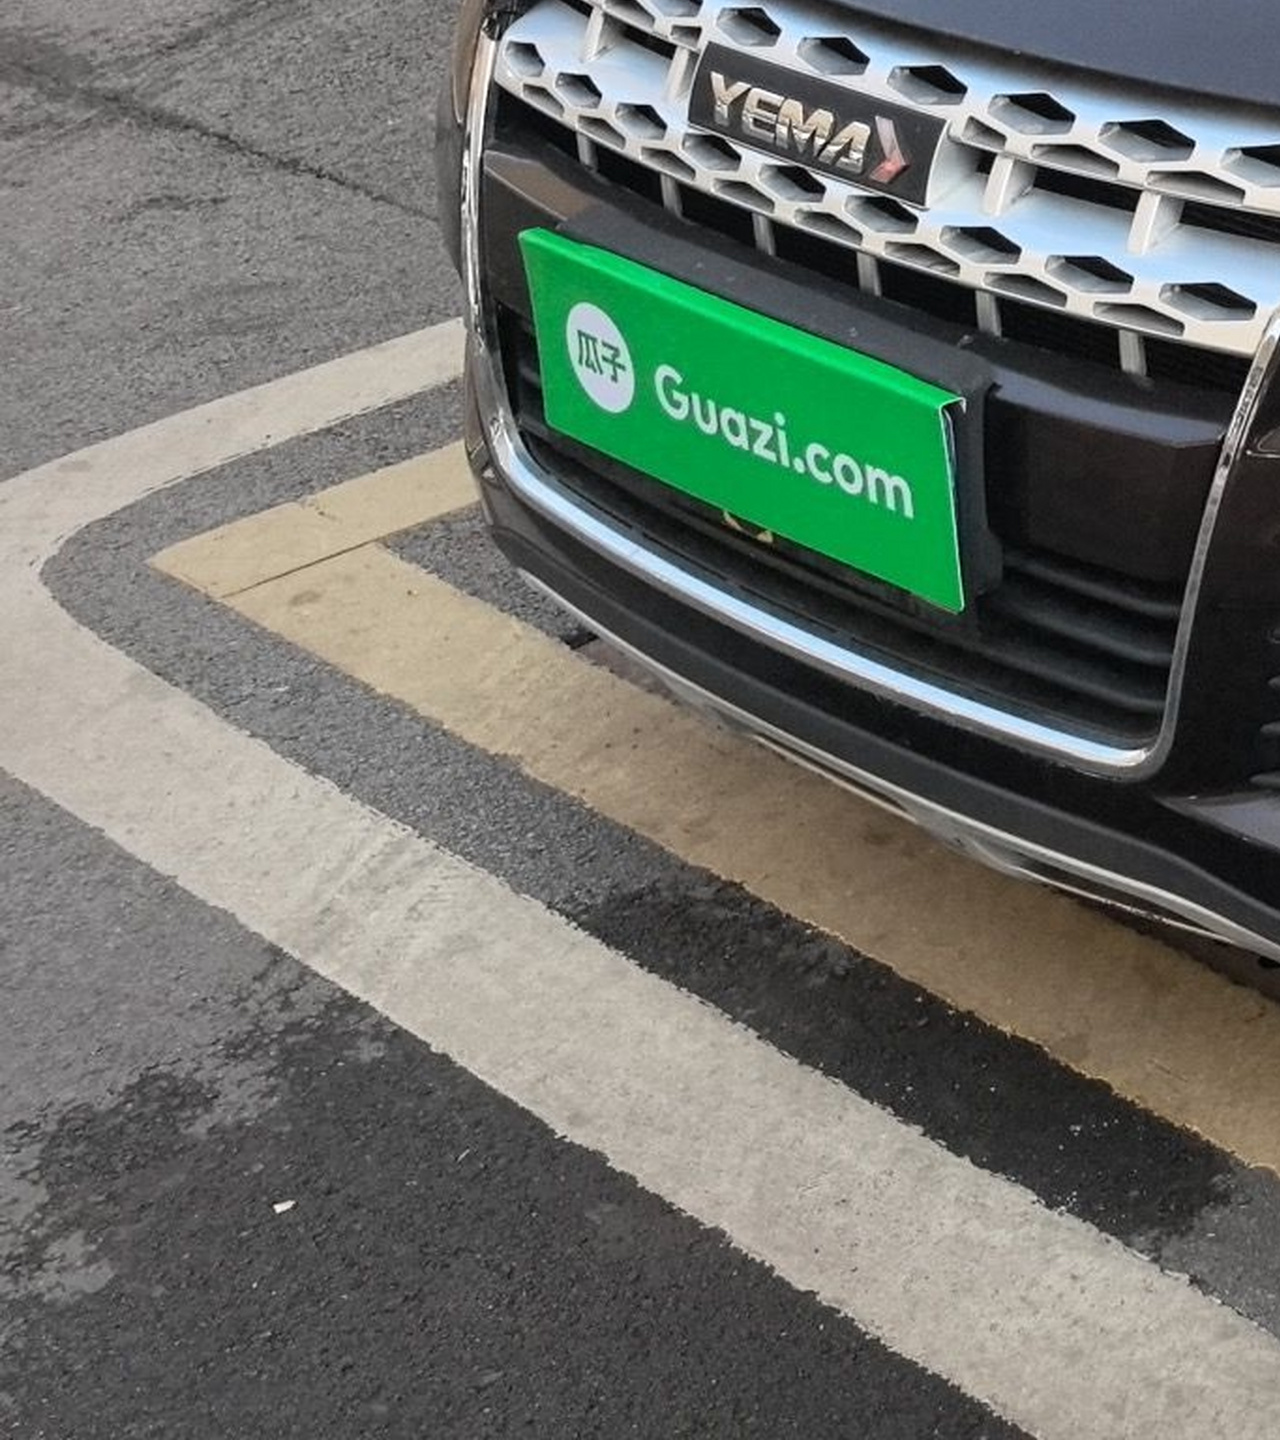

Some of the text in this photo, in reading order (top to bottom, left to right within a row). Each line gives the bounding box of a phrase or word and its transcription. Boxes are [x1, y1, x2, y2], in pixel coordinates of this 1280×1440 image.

[710, 71, 871, 174] YEMA
[576, 328, 627, 385] 瓜子
[653, 363, 915, 520] Guazi.com
